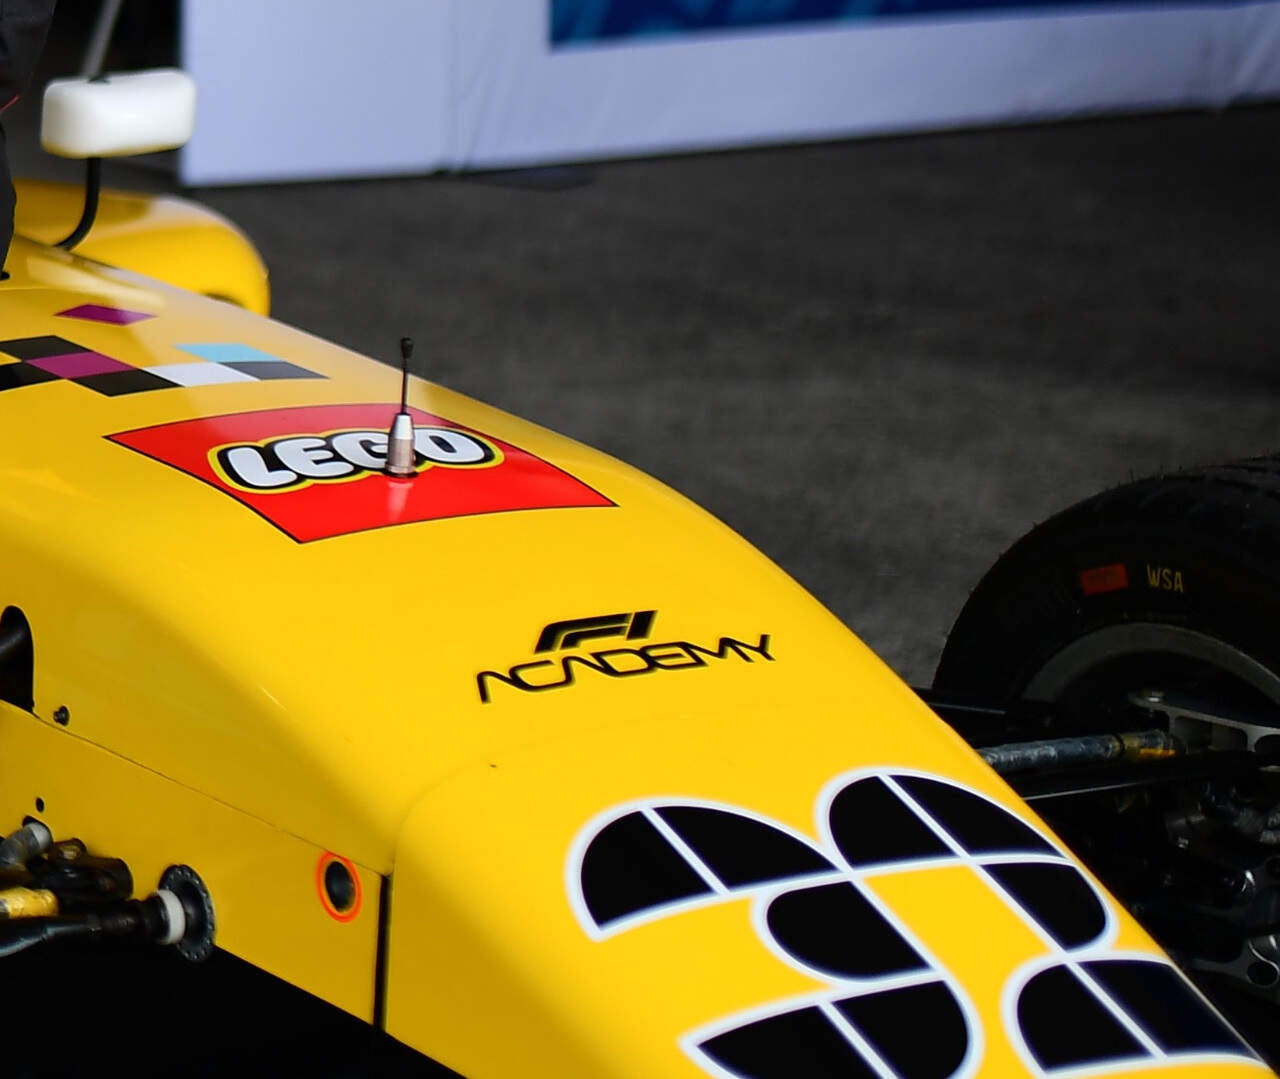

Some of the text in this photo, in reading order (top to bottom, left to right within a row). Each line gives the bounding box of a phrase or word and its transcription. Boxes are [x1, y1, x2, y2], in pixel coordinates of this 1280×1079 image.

[226, 427, 486, 488] LEGO
[475, 633, 776, 704] ACADEMY
[564, 766, 1272, 1079] 32
